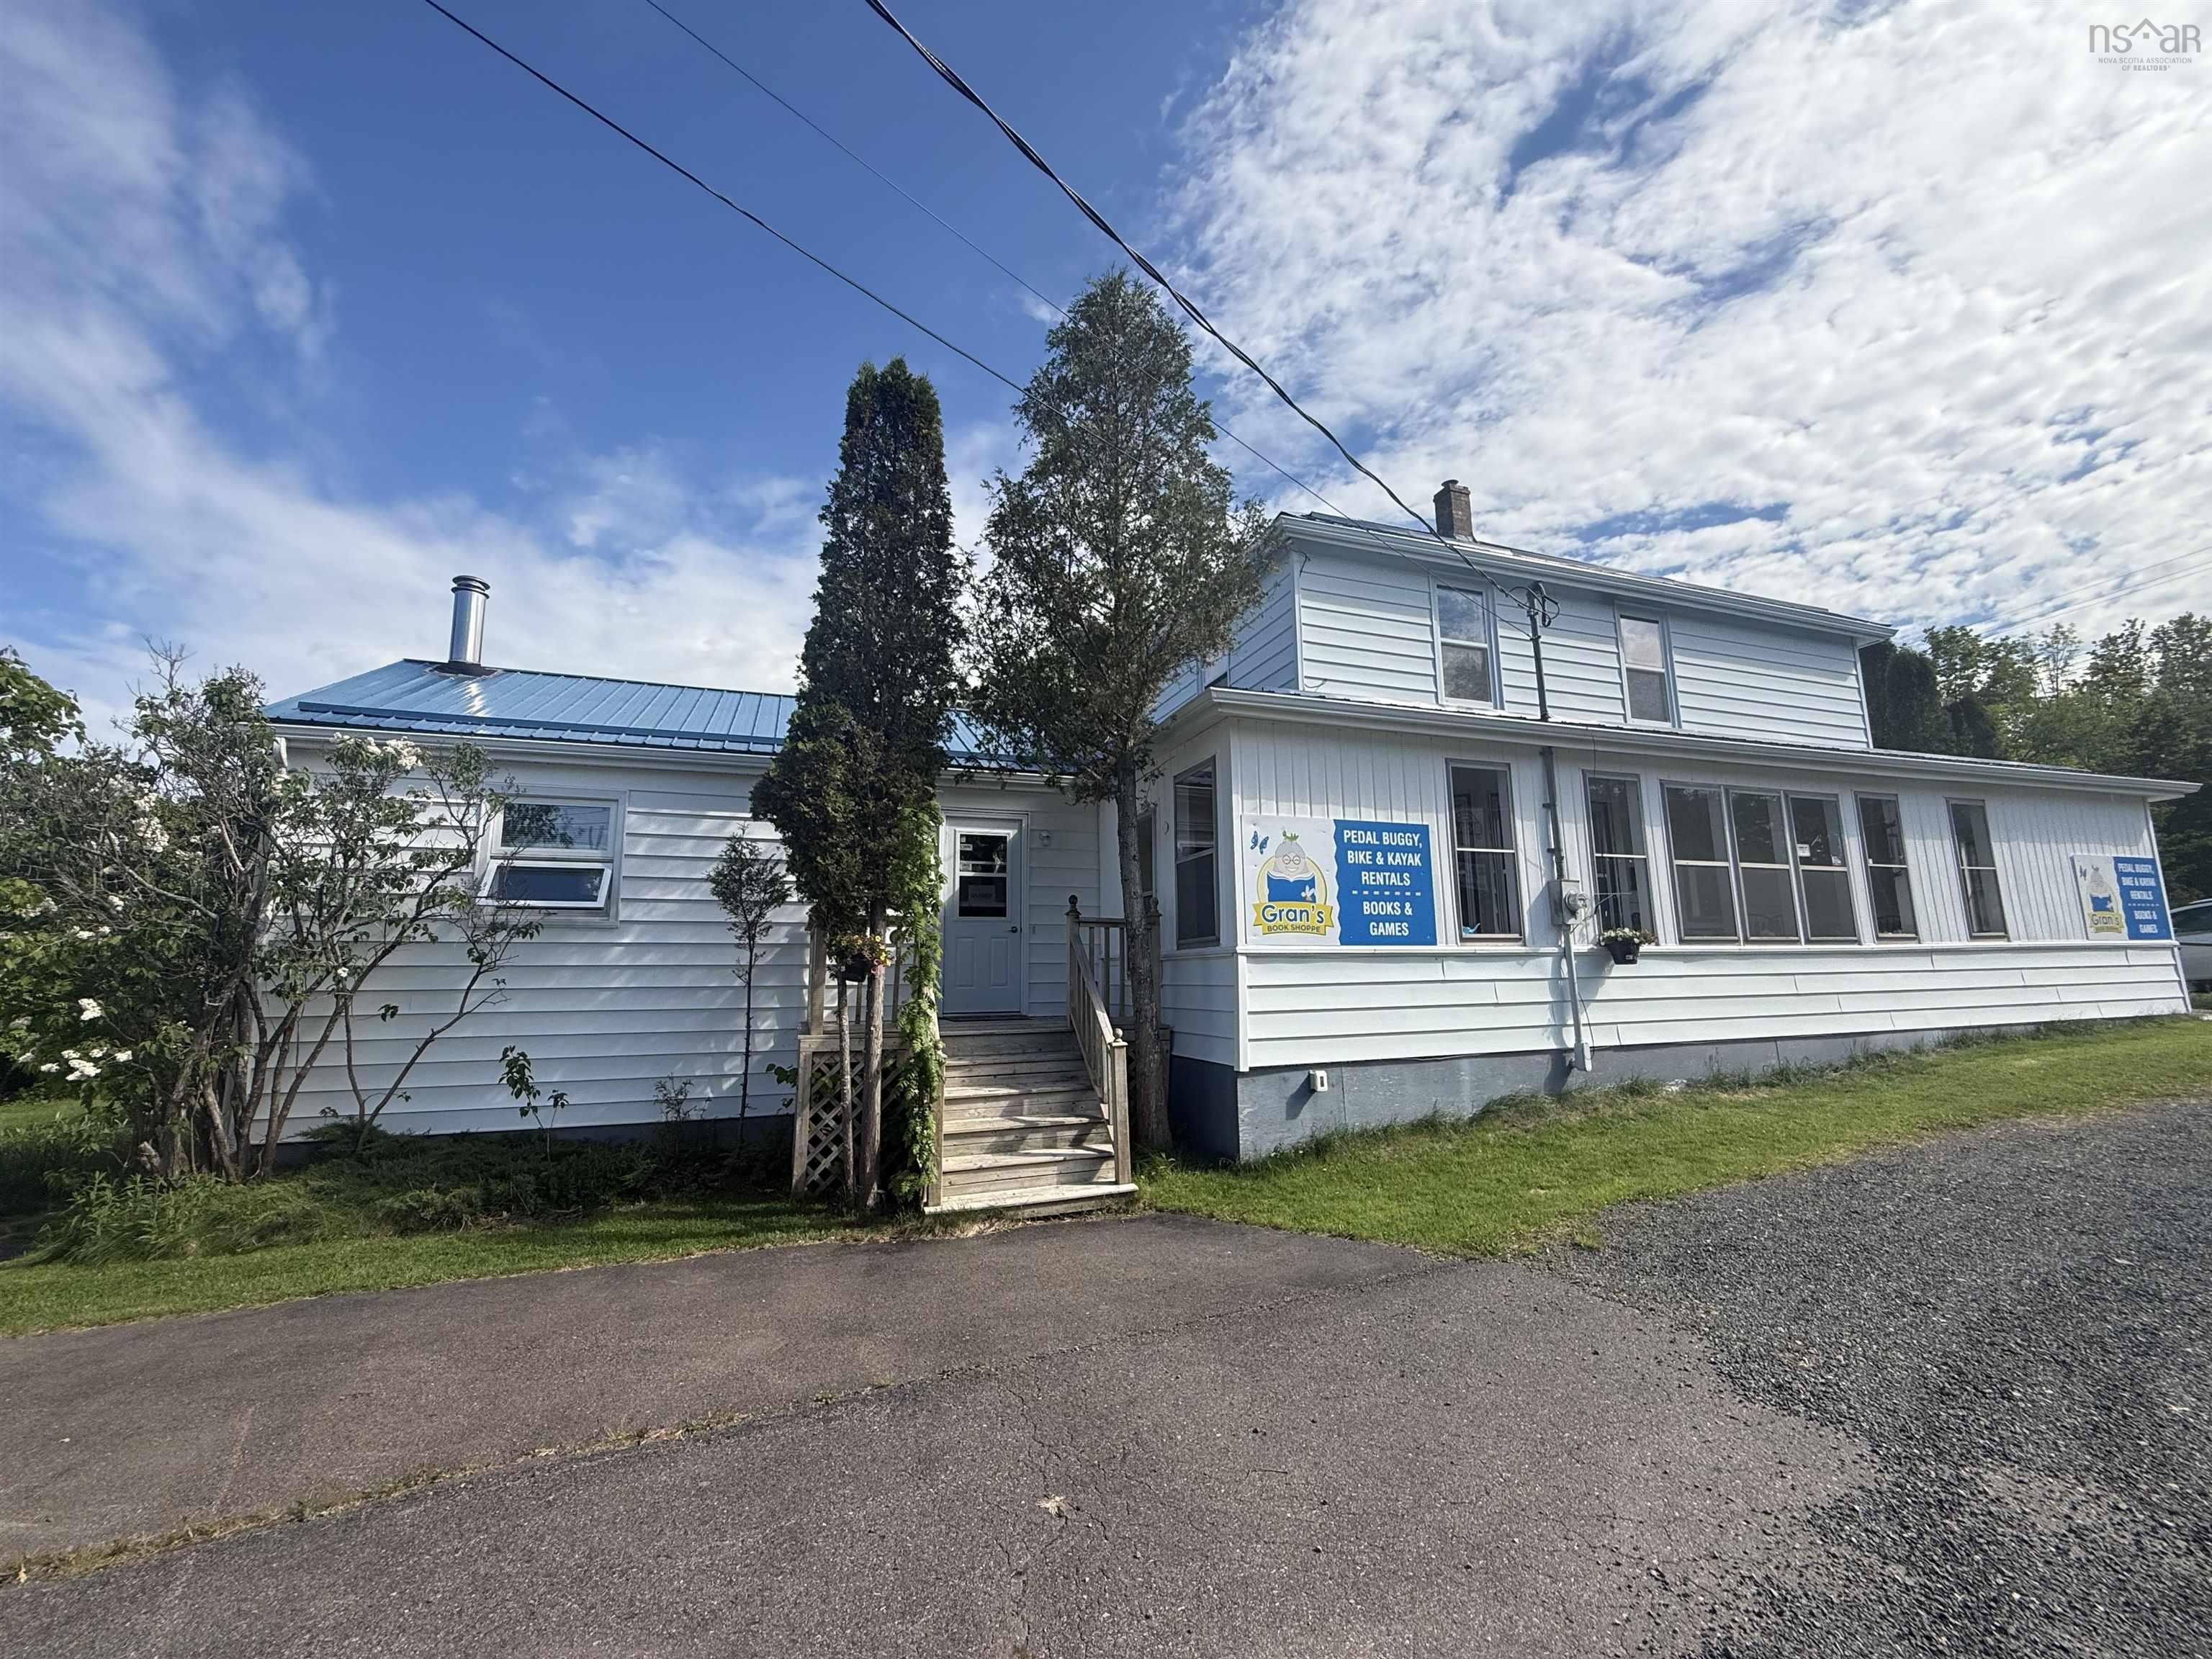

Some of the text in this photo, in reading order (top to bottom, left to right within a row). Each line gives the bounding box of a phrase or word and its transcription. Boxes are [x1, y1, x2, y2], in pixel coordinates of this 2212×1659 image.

[1343, 830, 1423, 849] PEDAL BUGGY,
[1347, 850, 1422, 866] BIKE & KAYAK
[1361, 871, 1411, 886] RENTALS
[1262, 904, 1324, 924] Gran's
[1362, 901, 1413, 916] BOOKS &
[2091, 913, 2121, 926] Grans
[1370, 922, 1409, 936] GAMES
